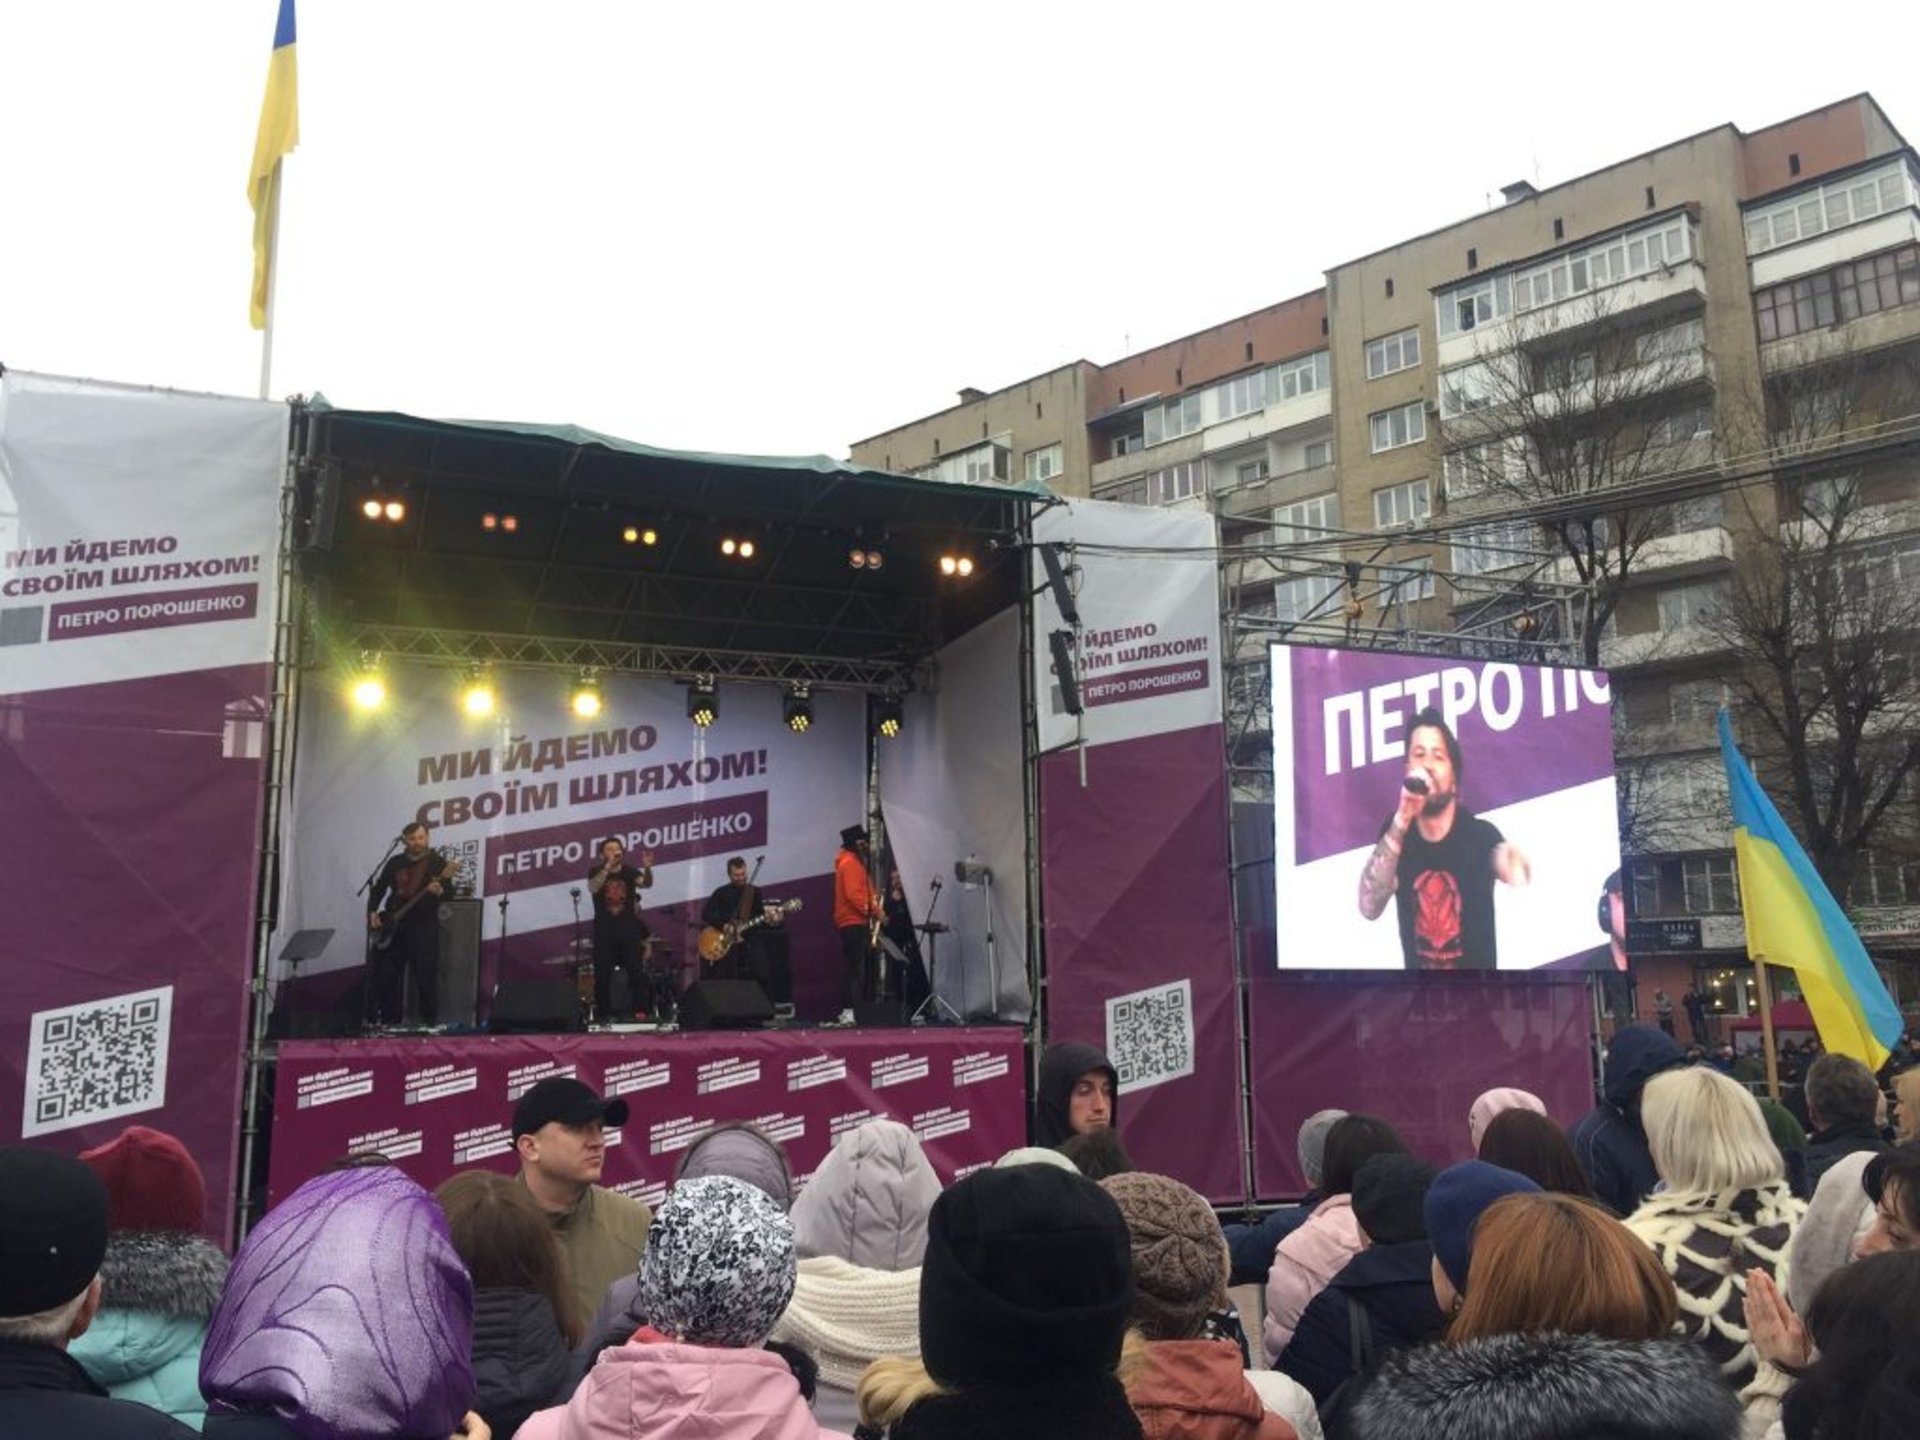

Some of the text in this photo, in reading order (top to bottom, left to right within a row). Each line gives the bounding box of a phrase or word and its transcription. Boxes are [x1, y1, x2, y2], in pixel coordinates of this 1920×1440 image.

[5, 536, 178, 569] МИ ЙДЕМО
[3, 555, 260, 596] СВОЇМ ШЛЯХОМ!
[57, 594, 246, 628] ПЕТРО ПОРОШЕНКО
[1084, 623, 1157, 649] ЙДЕМО
[1117, 636, 1208, 664] ШЛЯХОМ!
[1088, 670, 1202, 698] ПЕТРО ПОРОШЕНКО
[1323, 662, 1524, 776] ПЕТРО
[418, 725, 657, 786] МИ ЙДЕМО
[416, 749, 768, 829] СВОЇМ ШЛЯХОМ!
